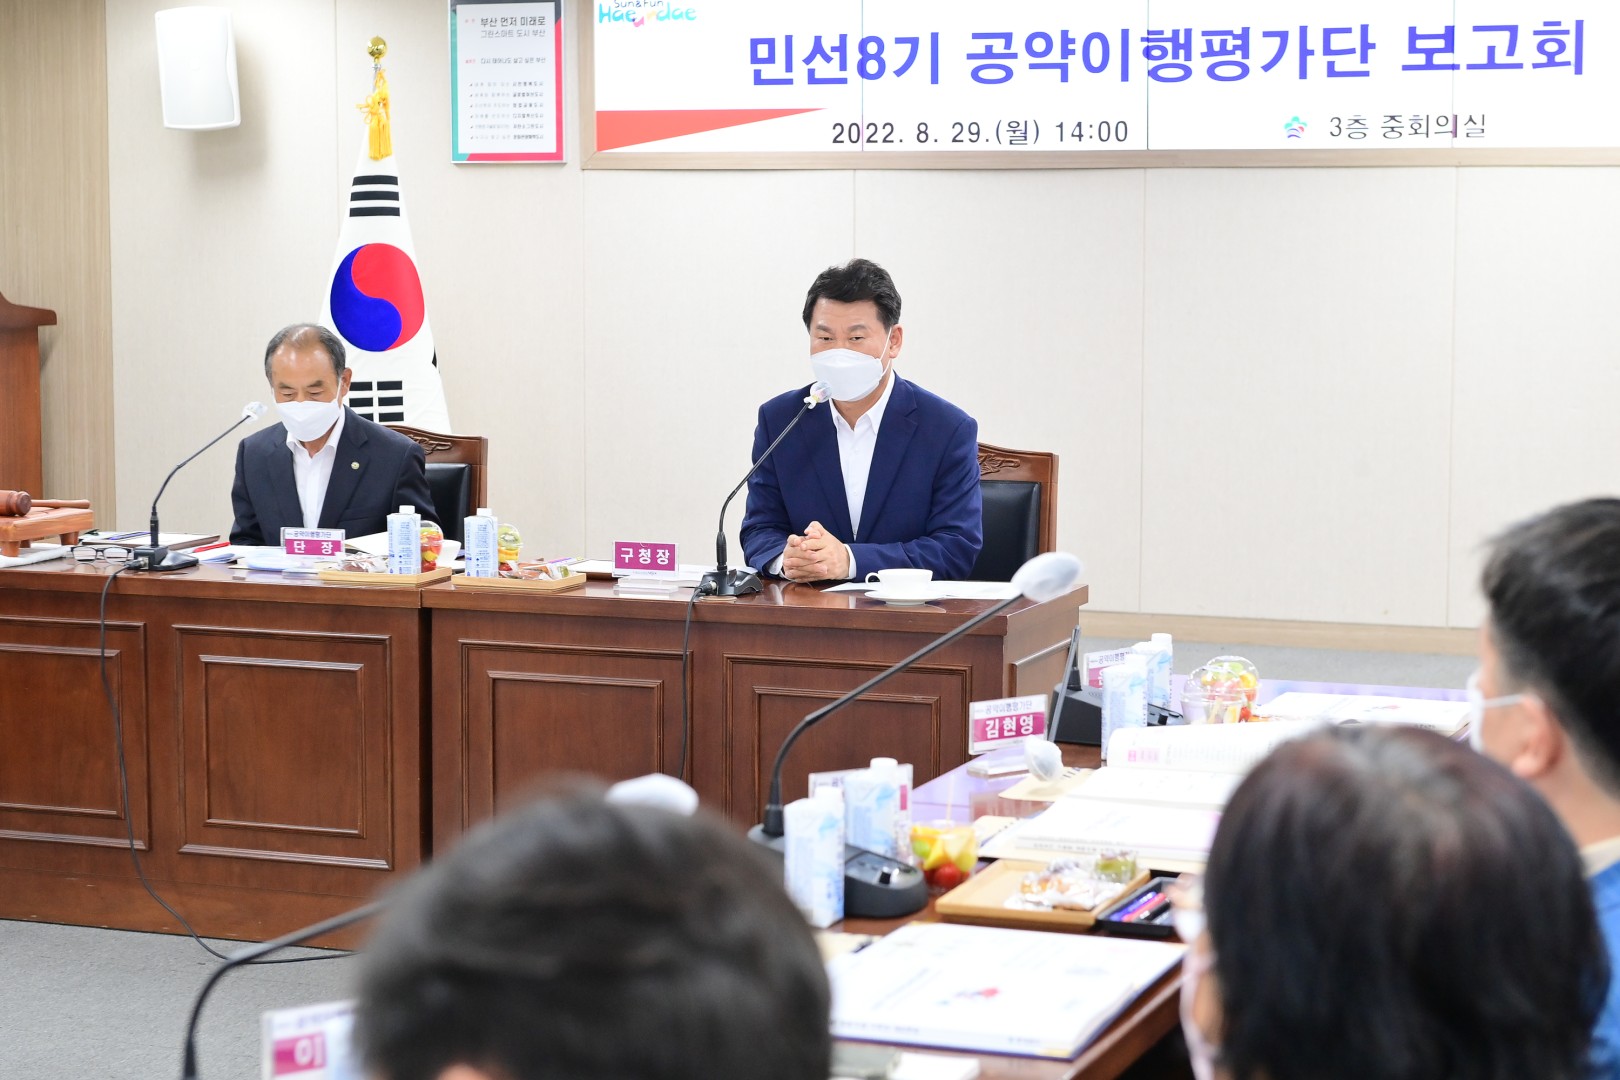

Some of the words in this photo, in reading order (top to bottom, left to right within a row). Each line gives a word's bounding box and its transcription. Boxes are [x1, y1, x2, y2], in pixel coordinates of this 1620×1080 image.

[480, 17, 498, 28] 부산
[500, 16, 517, 27] 먼저
[520, 16, 546, 26] 미래로
[750, 31, 939, 86] 민선8기
[966, 24, 1377, 84] 공약이행평가단
[1401, 19, 1584, 71] 보고회
[832, 122, 903, 144] 2022.
[916, 122, 938, 143] 8.
[1055, 121, 1128, 143] 14:00
[1329, 116, 1369, 139] 3층
[1380, 113, 1486, 138] 중회의실
[620, 547, 670, 565] 구청장
[985, 714, 1034, 739] 김현영
